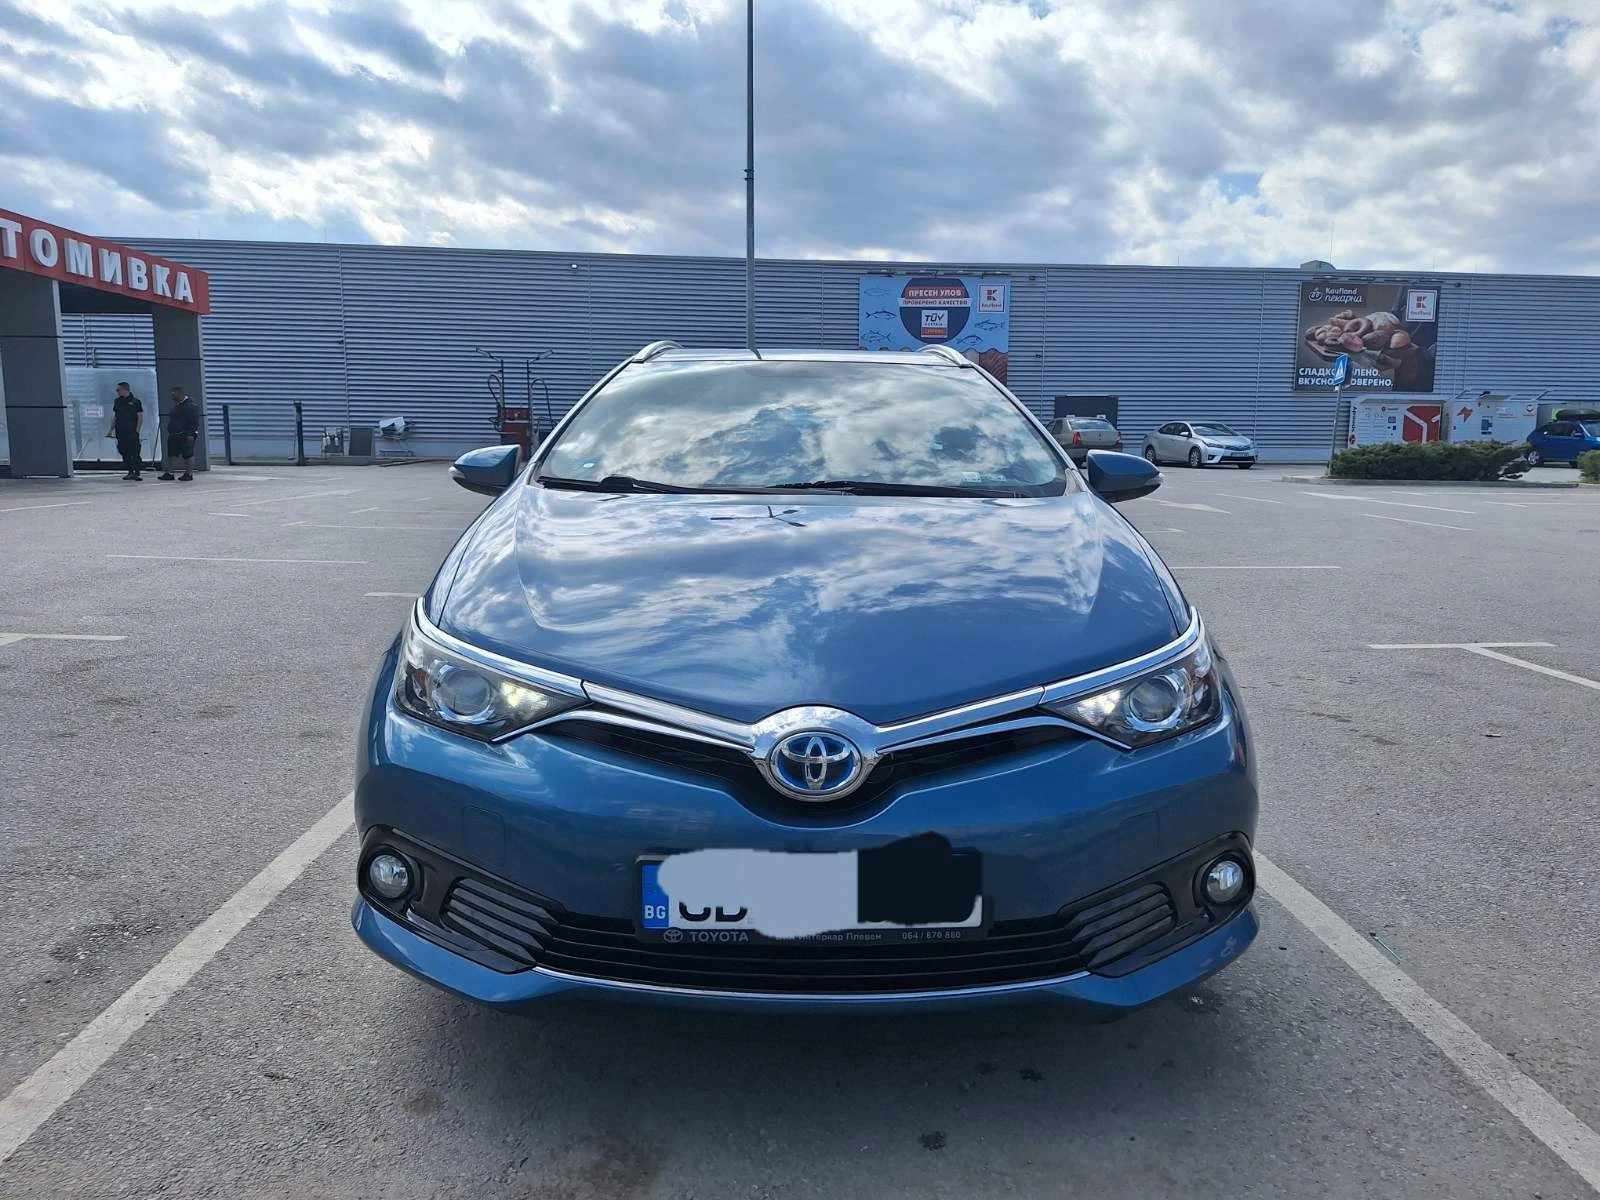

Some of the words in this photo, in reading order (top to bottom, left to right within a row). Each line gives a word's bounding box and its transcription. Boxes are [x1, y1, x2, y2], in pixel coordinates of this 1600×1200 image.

[908, 289, 939, 297] ПРЕСЕН
[940, 289, 962, 297] УЛОВ
[1325, 287, 1358, 295] Kaufland
[924, 312, 944, 322] TÜV
[644, 905, 666, 919] BG
[689, 931, 749, 942] TOYOTA
